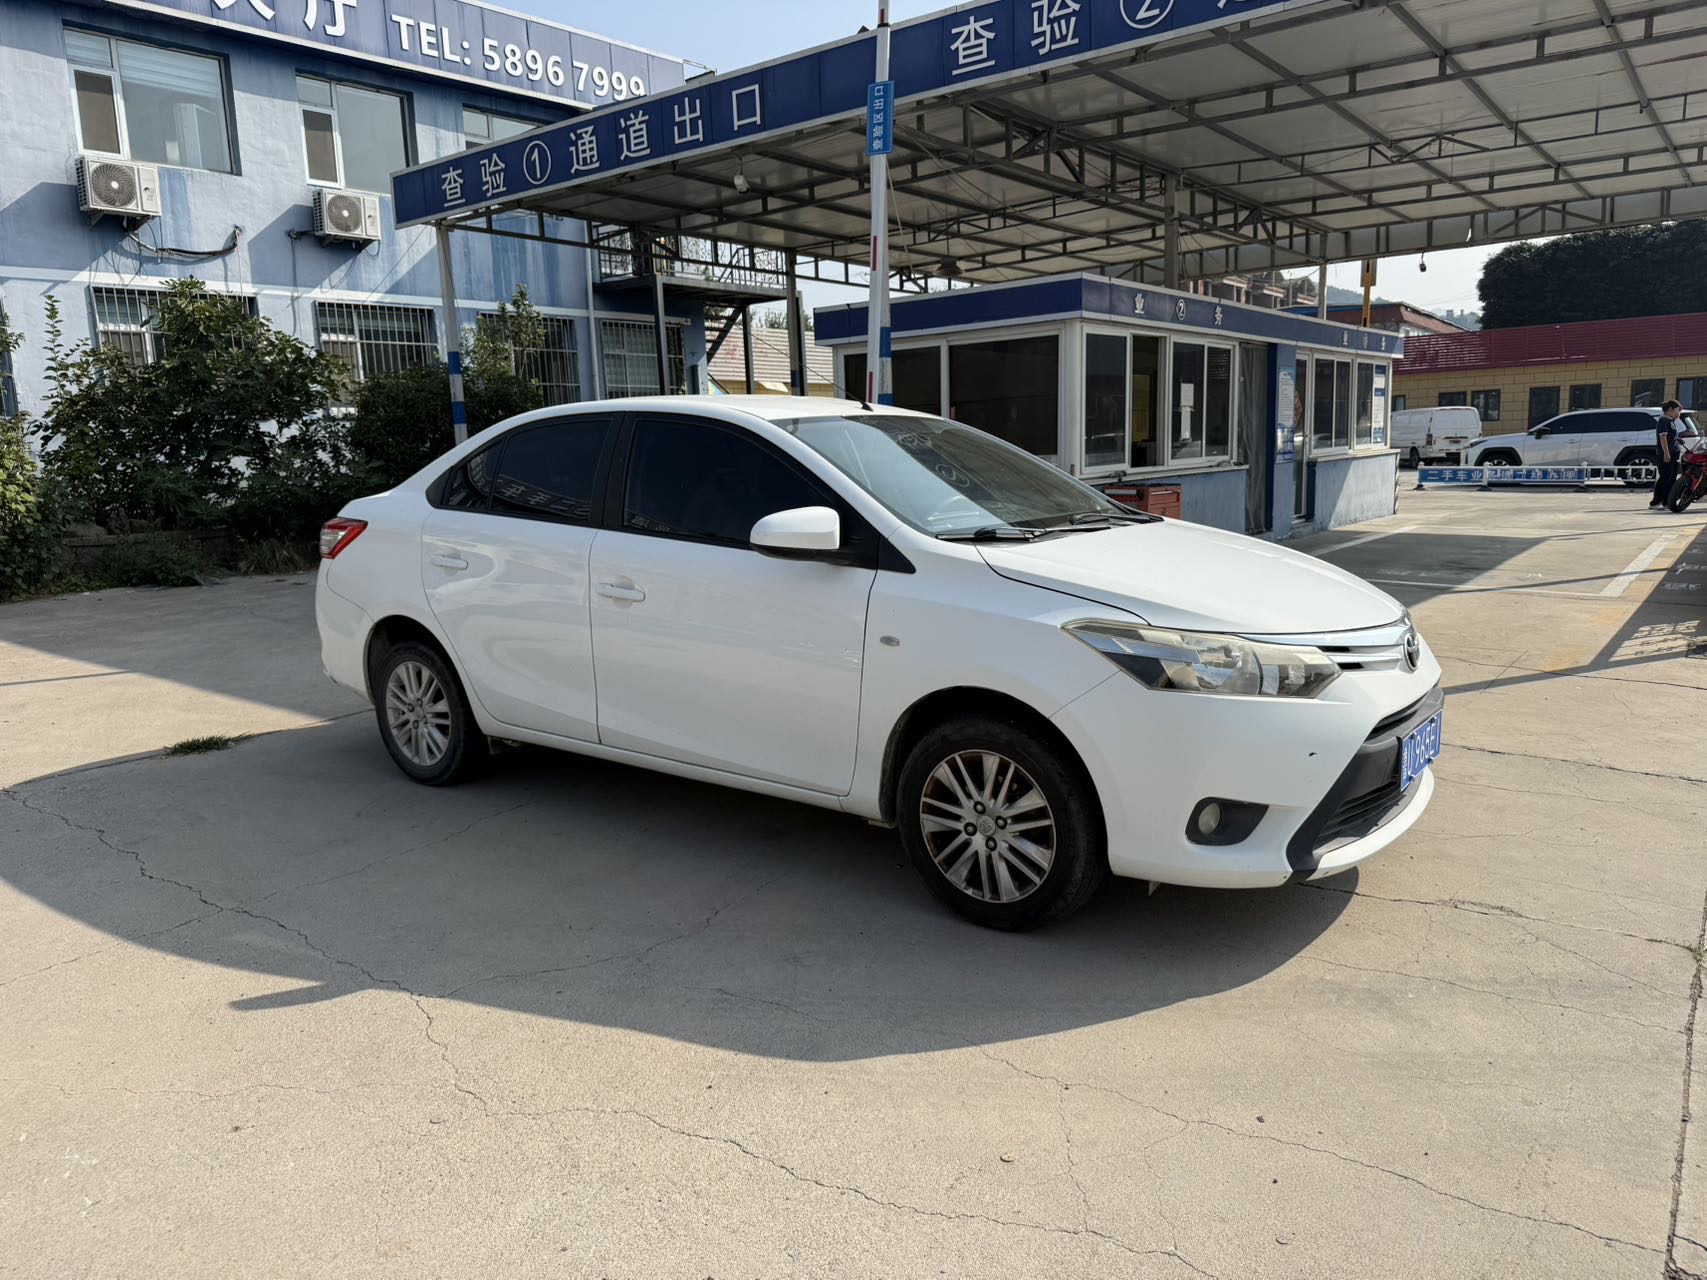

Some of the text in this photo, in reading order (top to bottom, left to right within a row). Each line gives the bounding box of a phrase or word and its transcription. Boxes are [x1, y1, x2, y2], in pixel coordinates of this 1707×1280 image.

[212, 0, 358, 37] 厅
[950, 0, 1247, 76] 查验②
[391, 14, 646, 101] TEL: 5896 7999
[872, 85, 884, 151] 查验区出口
